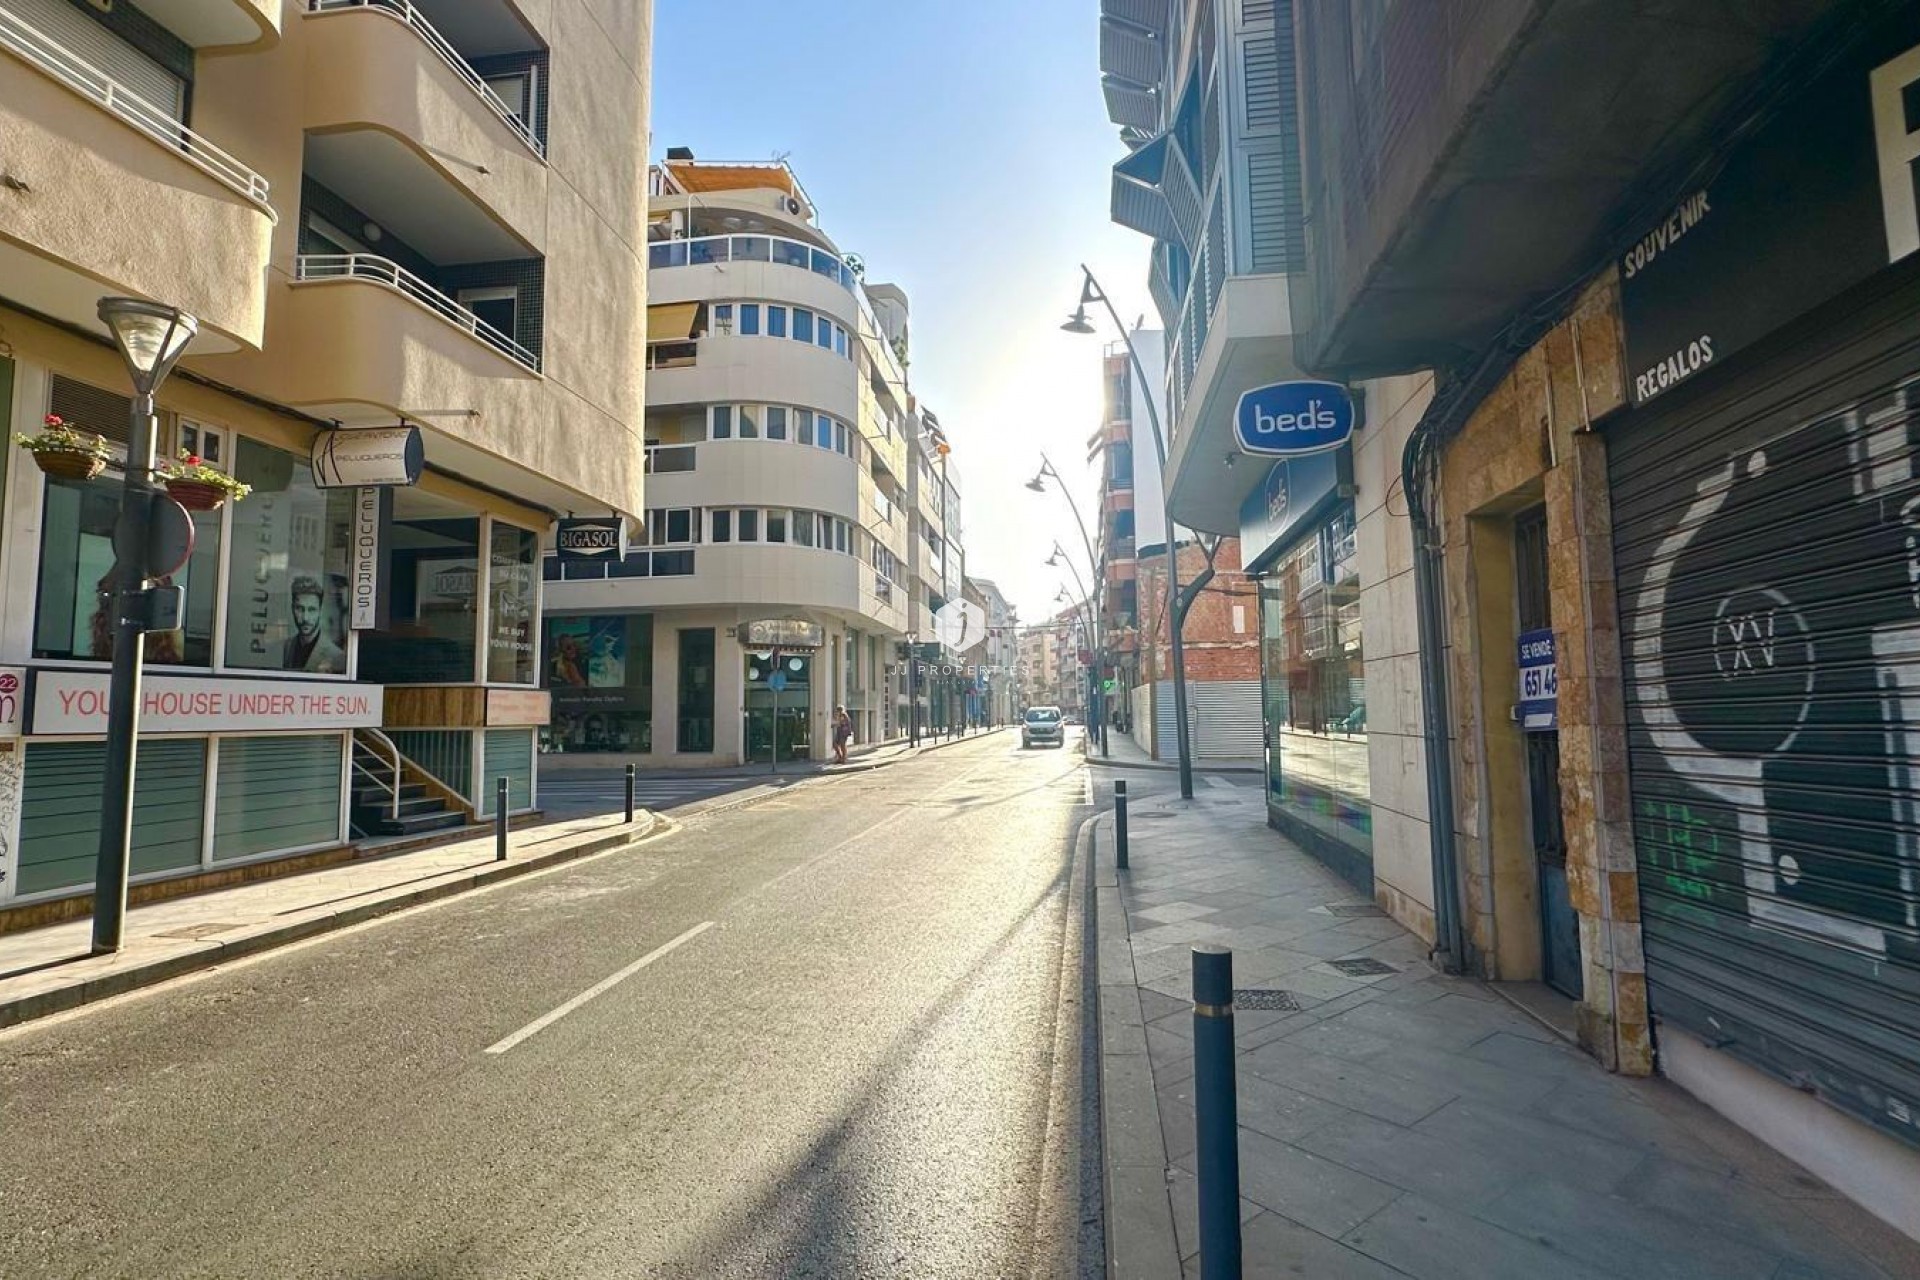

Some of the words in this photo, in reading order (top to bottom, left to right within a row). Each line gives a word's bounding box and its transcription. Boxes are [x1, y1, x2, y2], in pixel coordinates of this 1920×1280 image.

[1625, 189, 1711, 279] SOUVENIR
[1636, 334, 1714, 402] REGALOS
[1254, 399, 1337, 434] bed's
[357, 487, 376, 609] PELUQUEROS
[560, 531, 618, 547] BIGASOL
[1521, 645, 1531, 659] SE
[1531, 639, 1553, 658] VENDE
[1525, 669, 1541, 697] 651
[143, 692, 222, 715] HOUSE
[229, 693, 294, 715] UNDER
[300, 695, 331, 715] THE
[336, 696, 371, 715] SUN.
